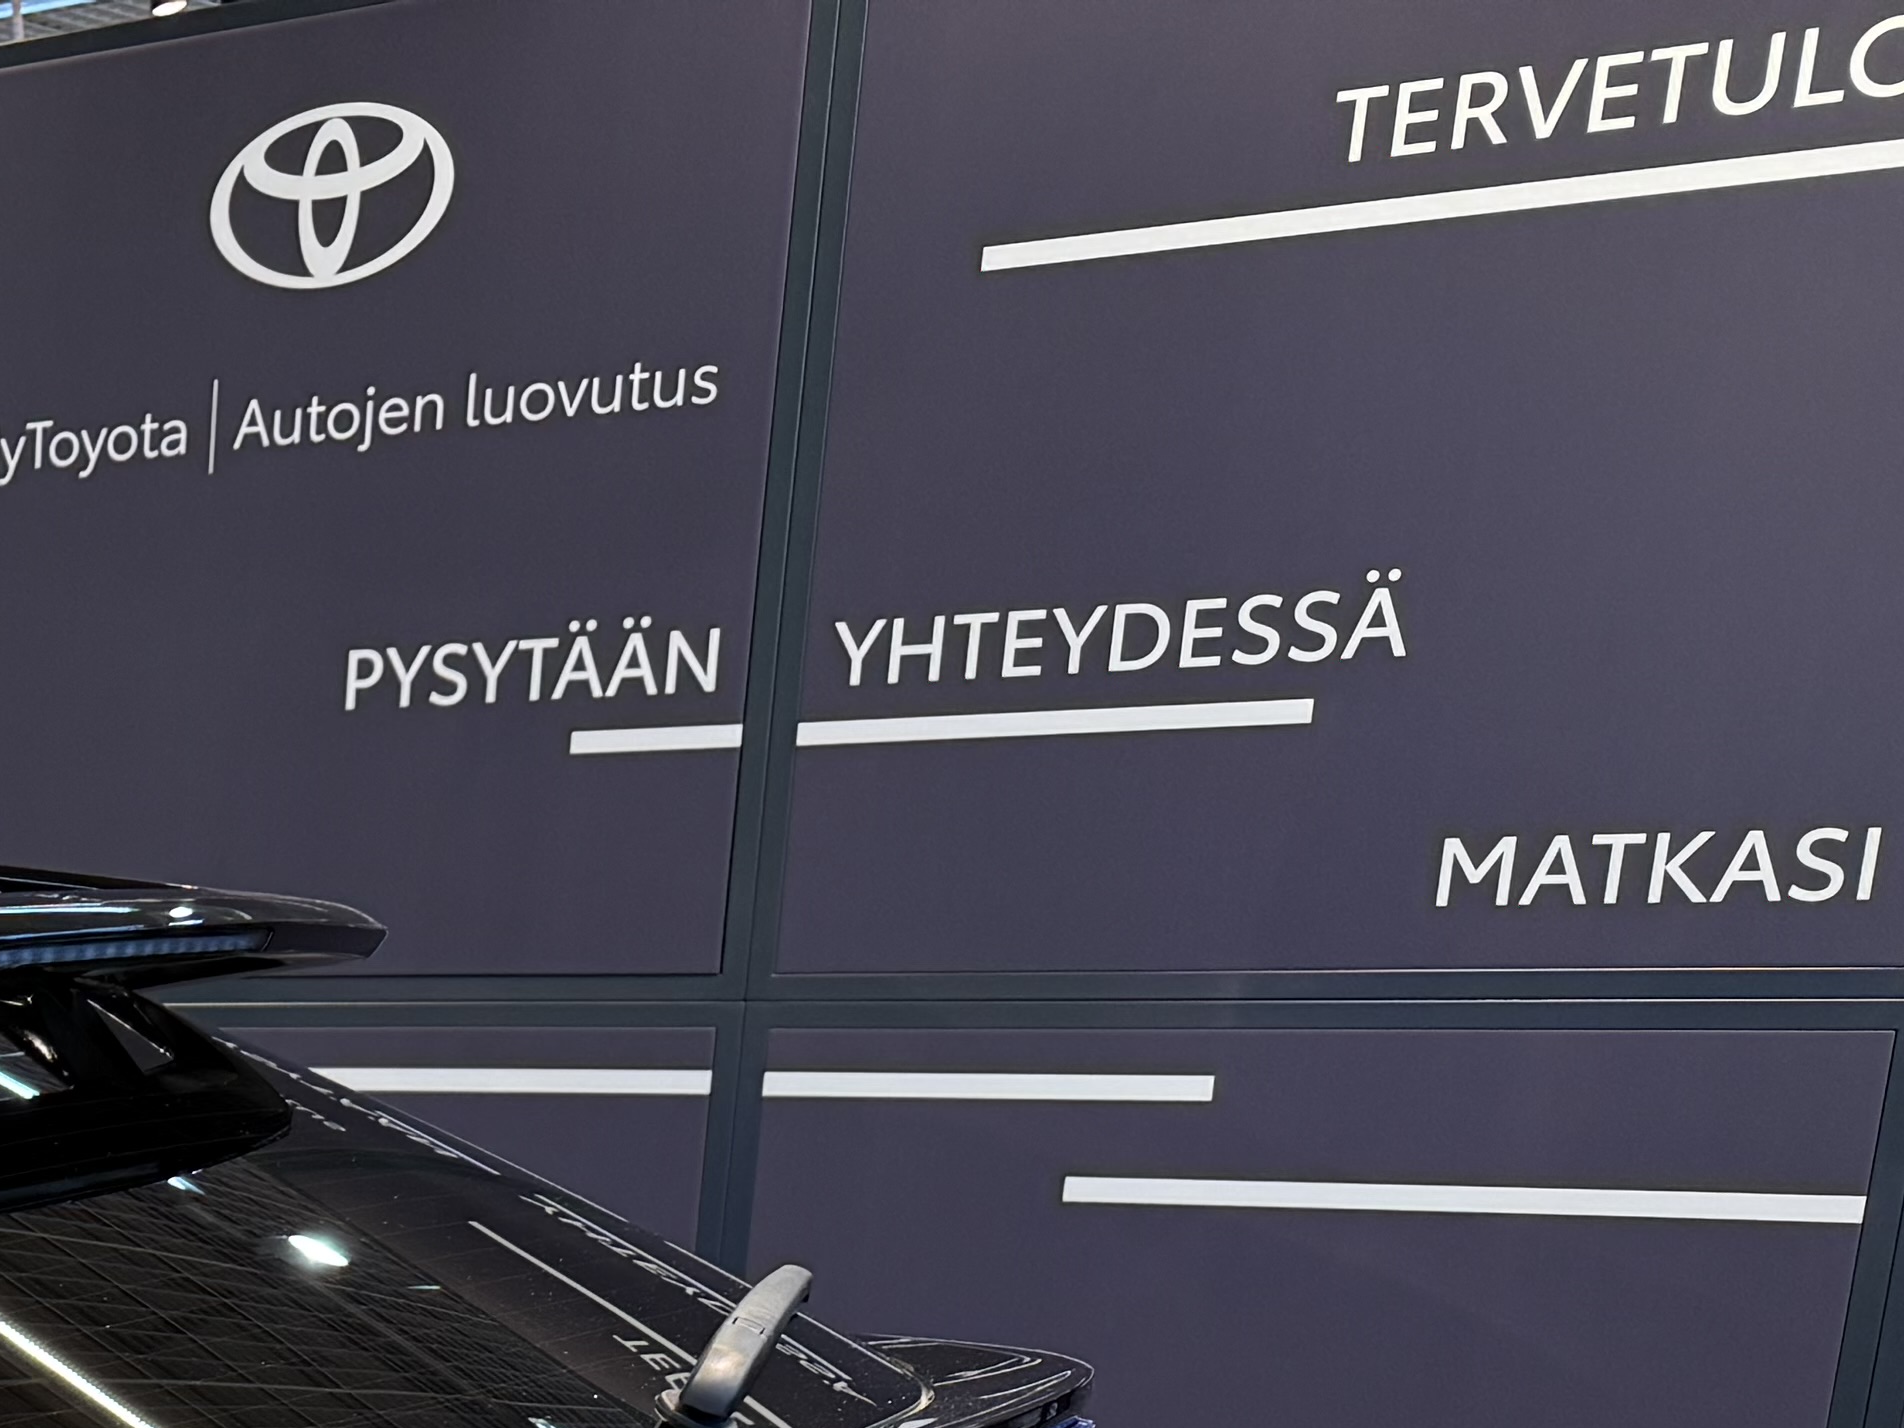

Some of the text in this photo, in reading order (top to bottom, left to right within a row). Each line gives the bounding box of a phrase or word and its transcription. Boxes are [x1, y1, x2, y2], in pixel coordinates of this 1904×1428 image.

[1335, 13, 1904, 163] TERVETULO
[232, 385, 445, 453] Autojen
[465, 361, 720, 428] luovutus
[344, 567, 1408, 712] PYSYTÄÄN YHTEYDESSÄ
[1434, 825, 1883, 908] MATKASI
